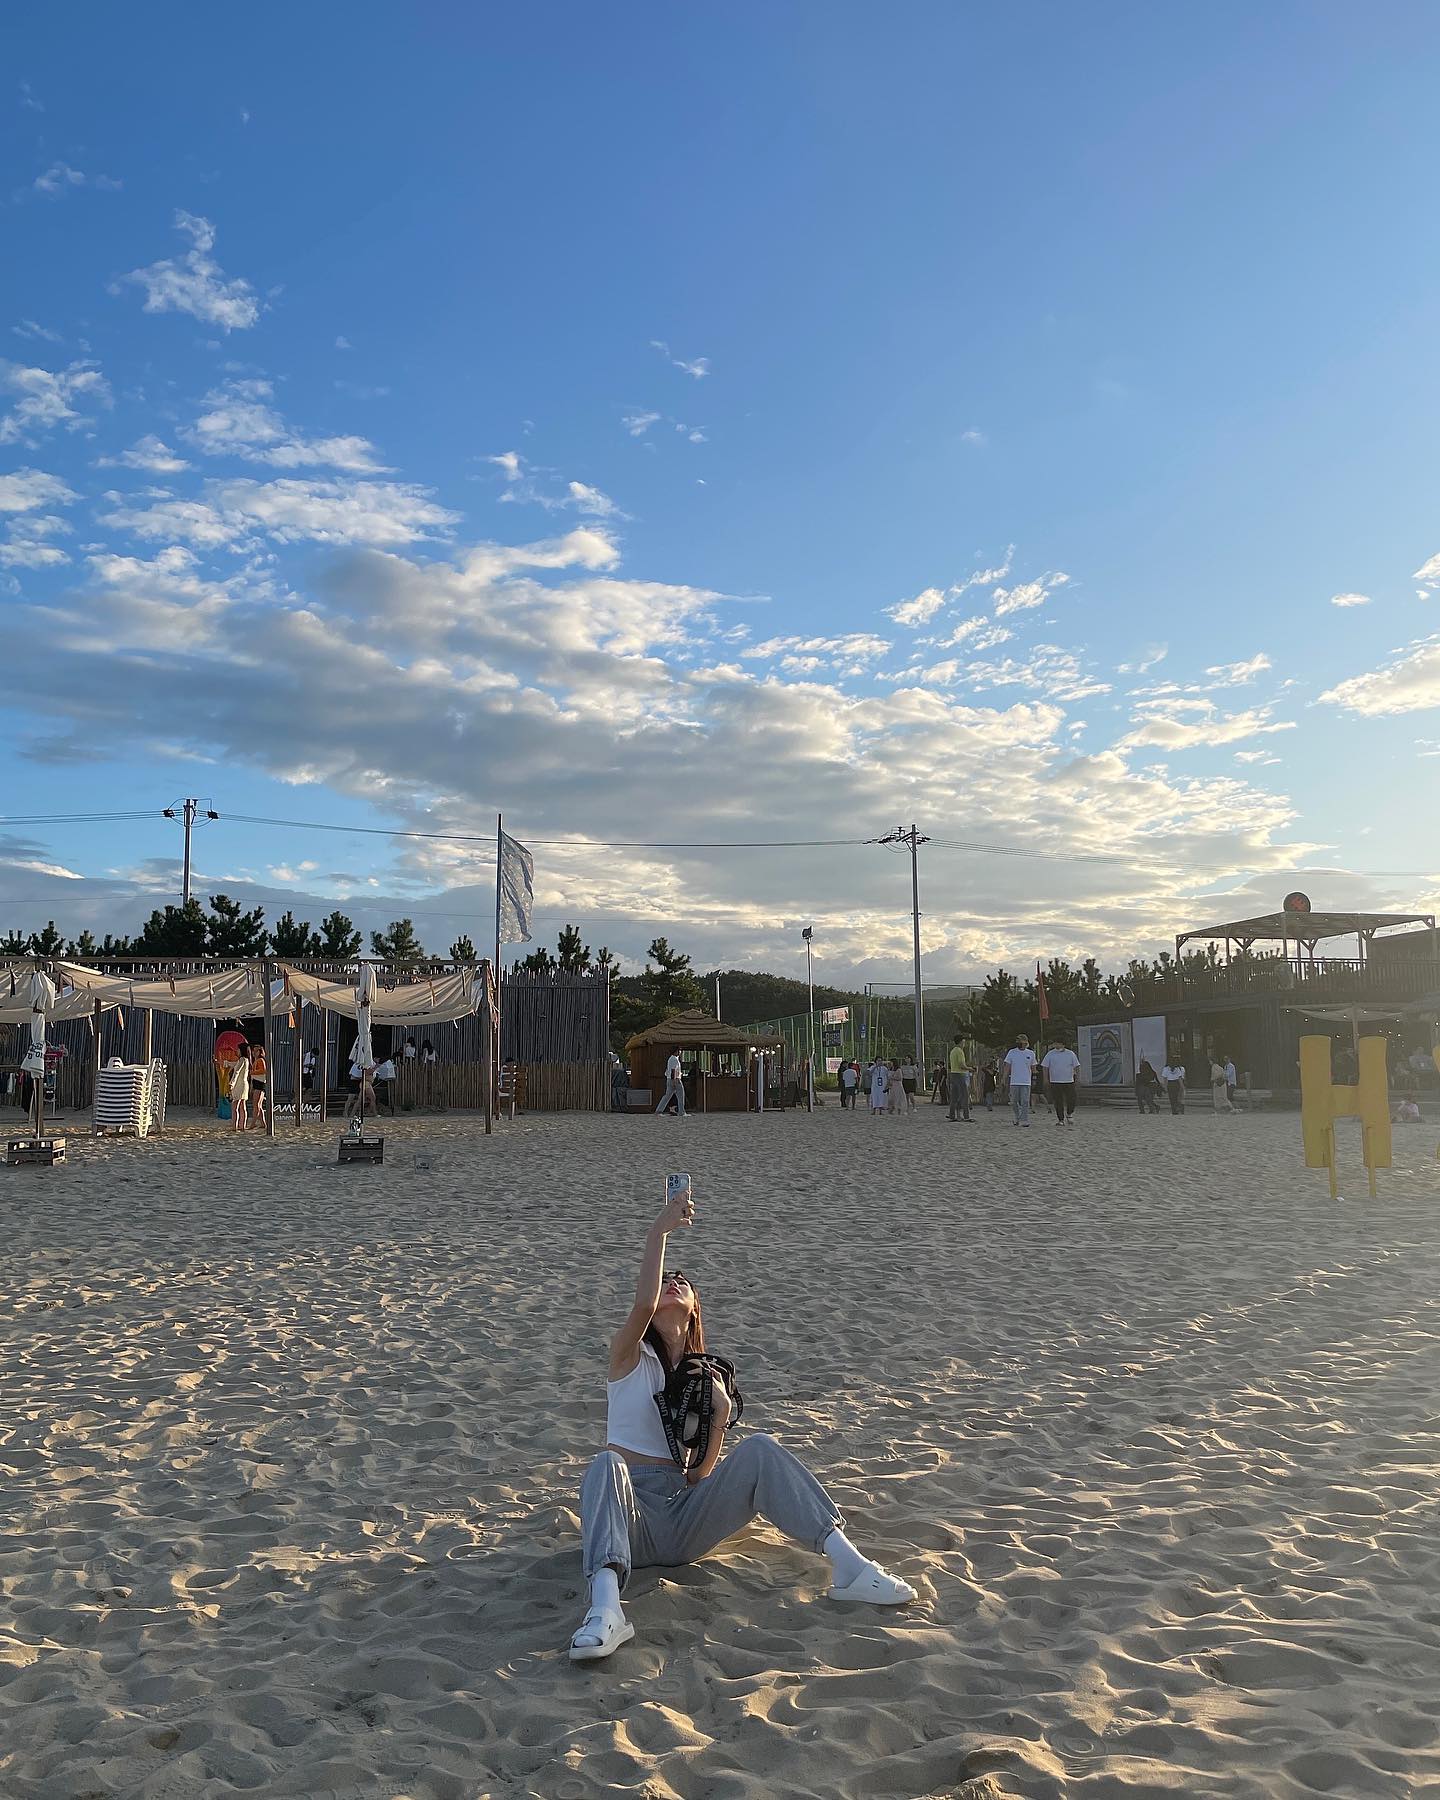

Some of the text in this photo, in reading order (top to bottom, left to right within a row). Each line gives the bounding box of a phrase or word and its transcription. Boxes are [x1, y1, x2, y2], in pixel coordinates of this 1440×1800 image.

[1299, 1034, 1440, 1168] H
[677, 1379, 697, 1424] ARMOUR
[702, 1380, 711, 1416] UNDER
